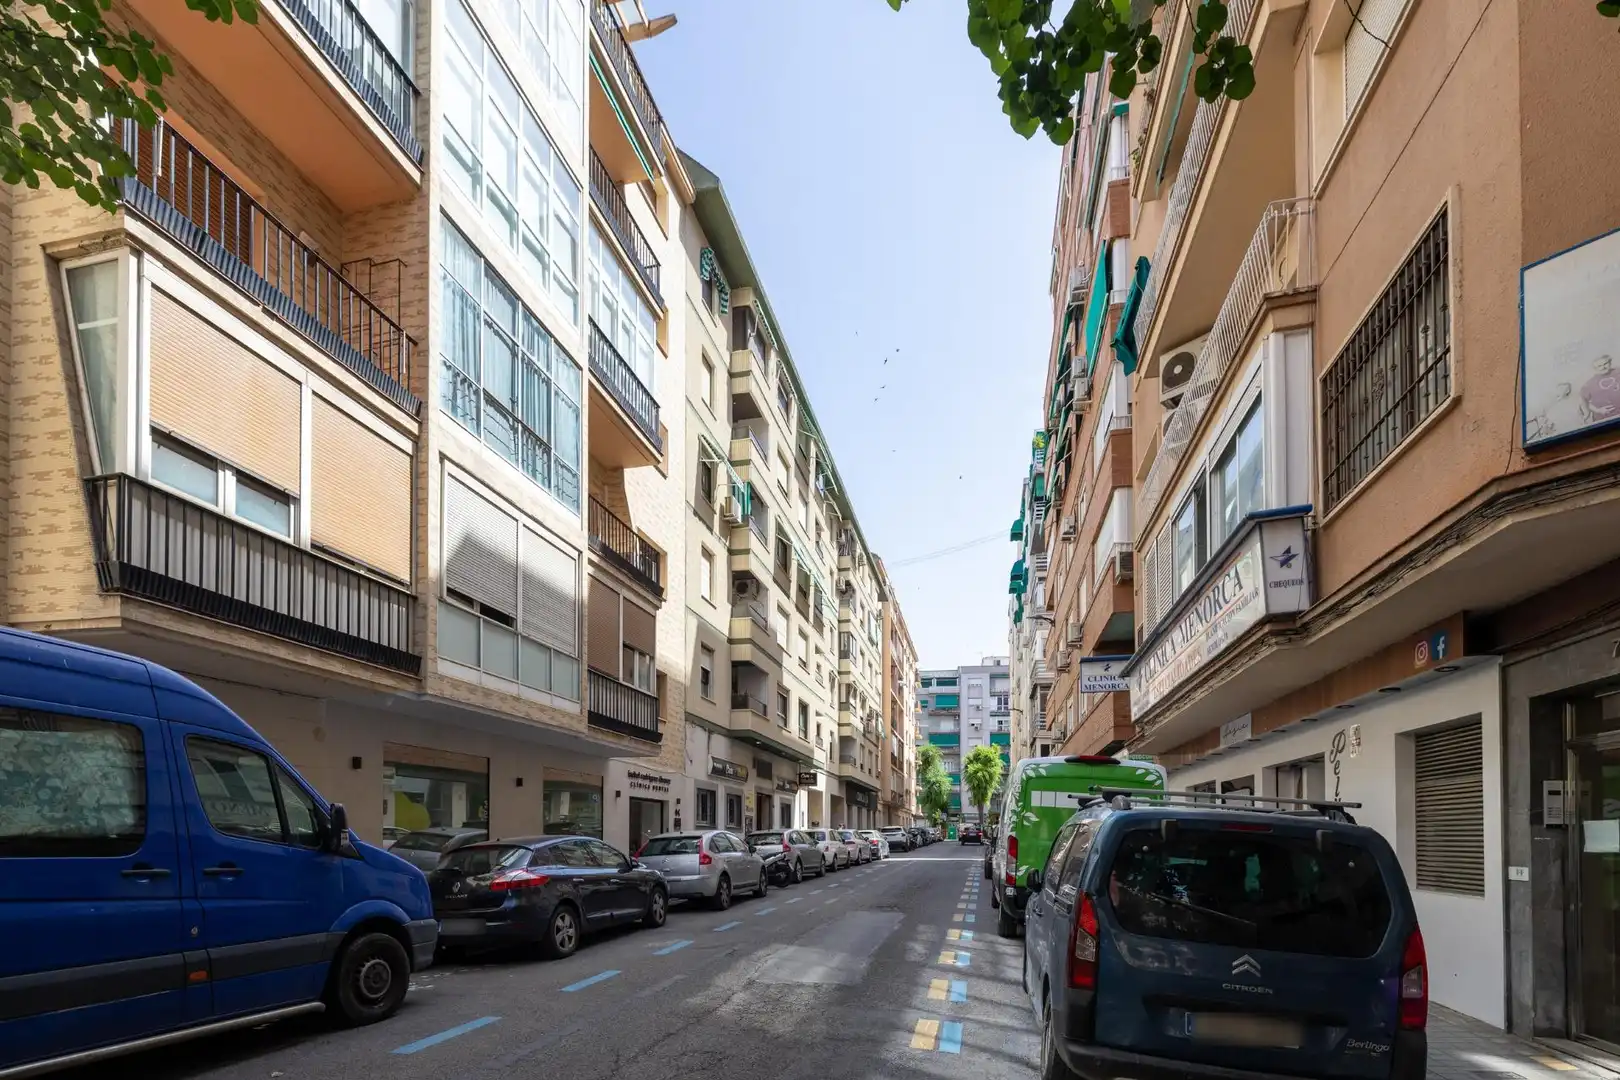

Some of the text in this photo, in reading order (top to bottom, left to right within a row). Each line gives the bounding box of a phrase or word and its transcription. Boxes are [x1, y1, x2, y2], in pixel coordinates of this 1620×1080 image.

[1179, 564, 1244, 649] MENORCA
[1087, 674, 1126, 683] CLINICA
[1084, 682, 1129, 691] MENORCA
[1329, 728, 1347, 803] Pel
[1346, 1038, 1391, 1053] Berlingo
